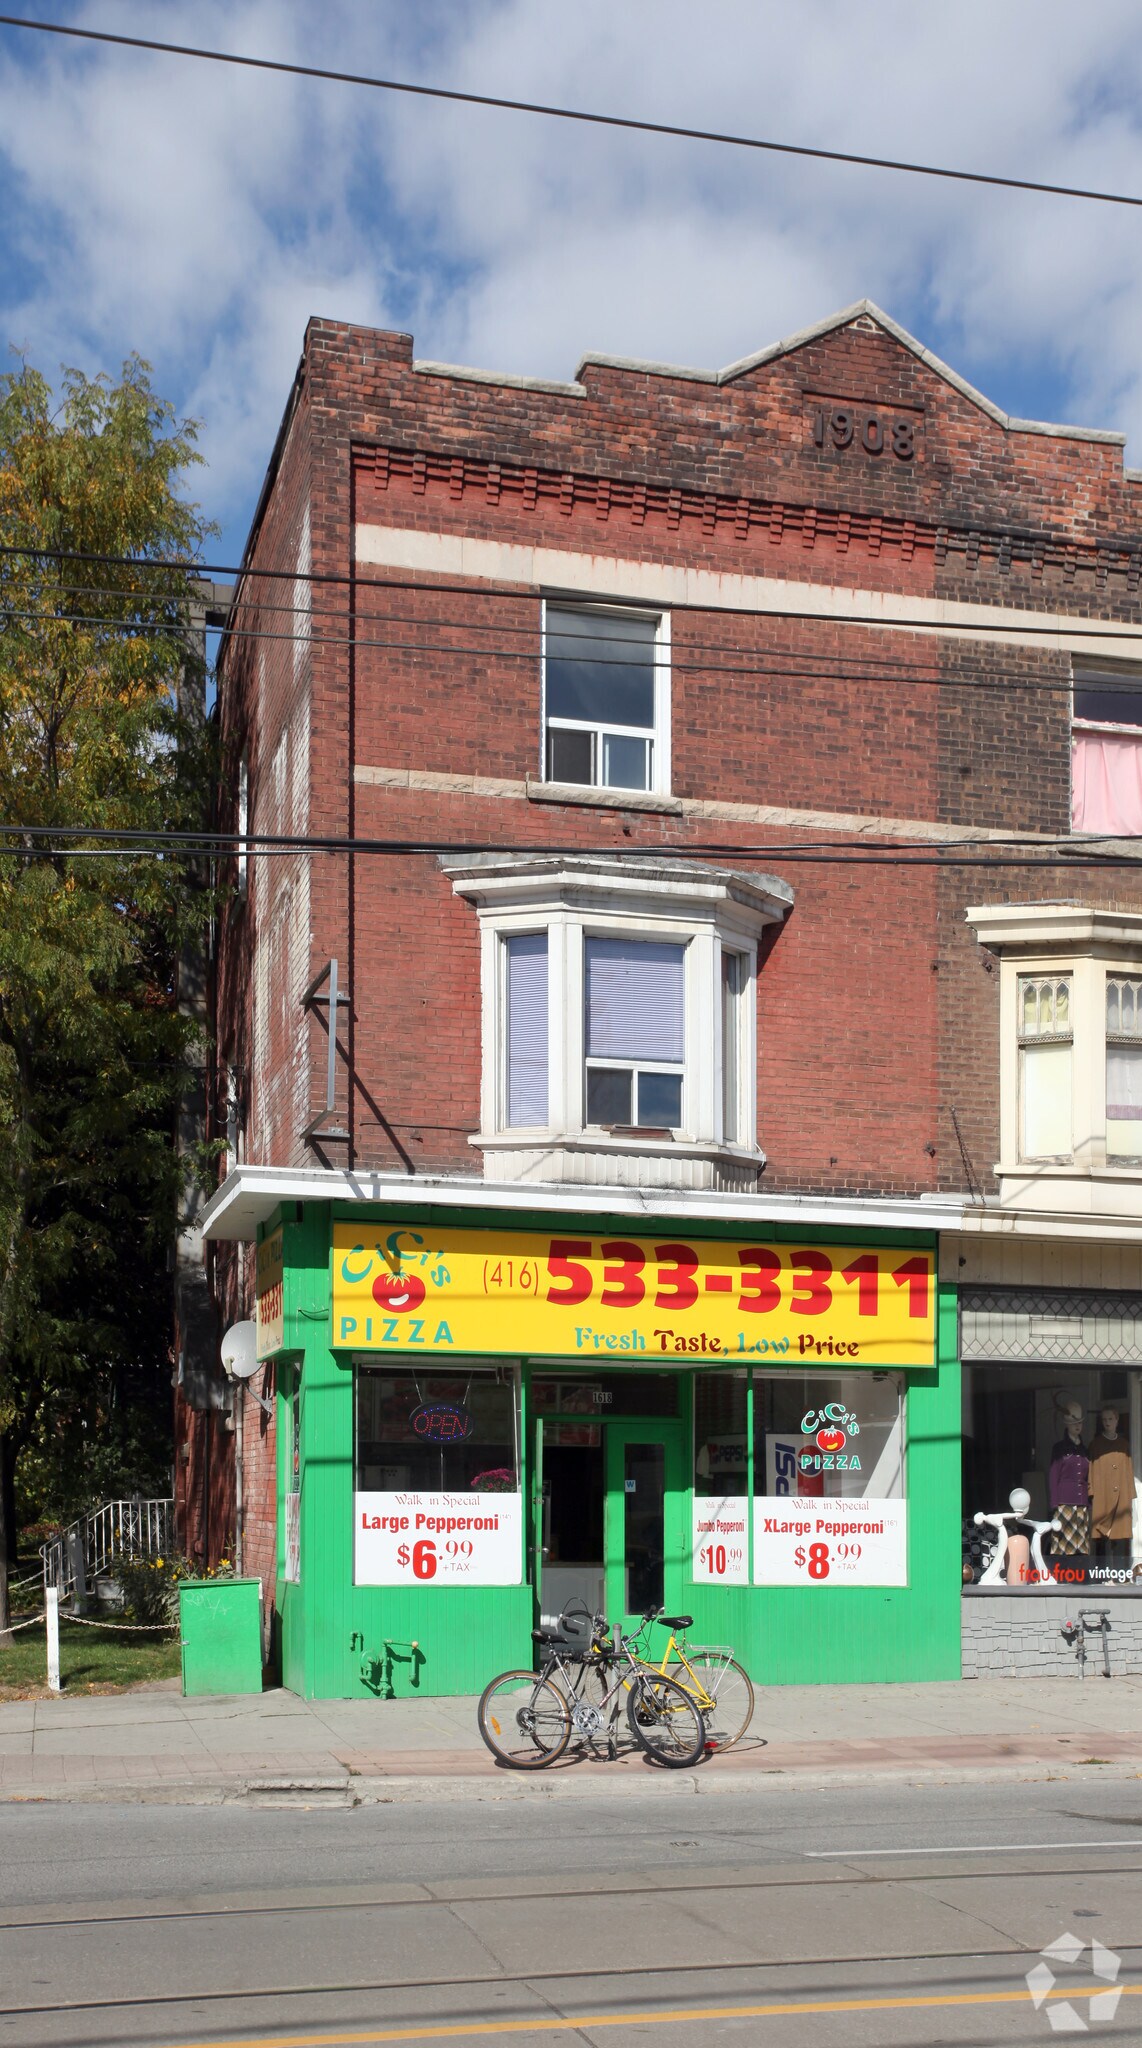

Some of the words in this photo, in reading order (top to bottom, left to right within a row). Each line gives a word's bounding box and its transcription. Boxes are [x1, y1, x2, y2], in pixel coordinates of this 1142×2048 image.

[814, 409, 914, 461] 1908
[483, 1259, 539, 1296] (416)
[546, 1239, 929, 1318] 533-3311
[340, 1316, 454, 1344] PIZZA
[575, 1327, 646, 1350] Fresh
[653, 1329, 729, 1357] Taste,
[737, 1332, 790, 1354] Low
[798, 1334, 860, 1357] Price
[593, 1392, 612, 1403] 1618
[413, 1412, 469, 1436] OPEN
[801, 1455, 862, 1470] PIZZA
[395, 1494, 423, 1506] Walk
[429, 1495, 439, 1505] in
[443, 1495, 480, 1508] Special
[792, 1499, 817, 1510] Walk
[823, 1500, 832, 1510] in
[835, 1500, 869, 1512] Special
[362, 1513, 409, 1533] Large
[415, 1513, 499, 1533] Pepperoni
[697, 1520, 715, 1532] Jumbo
[717, 1519, 744, 1535] Pepperoni
[764, 1519, 811, 1536] XLarge
[816, 1520, 884, 1537] Pepperoni
[397, 1540, 473, 1580] $6.99
[443, 1563, 470, 1572] +TAX
[700, 1545, 742, 1574] $10.99
[794, 1542, 862, 1580] $8.99
[1089, 1566, 1133, 1582] vintage
